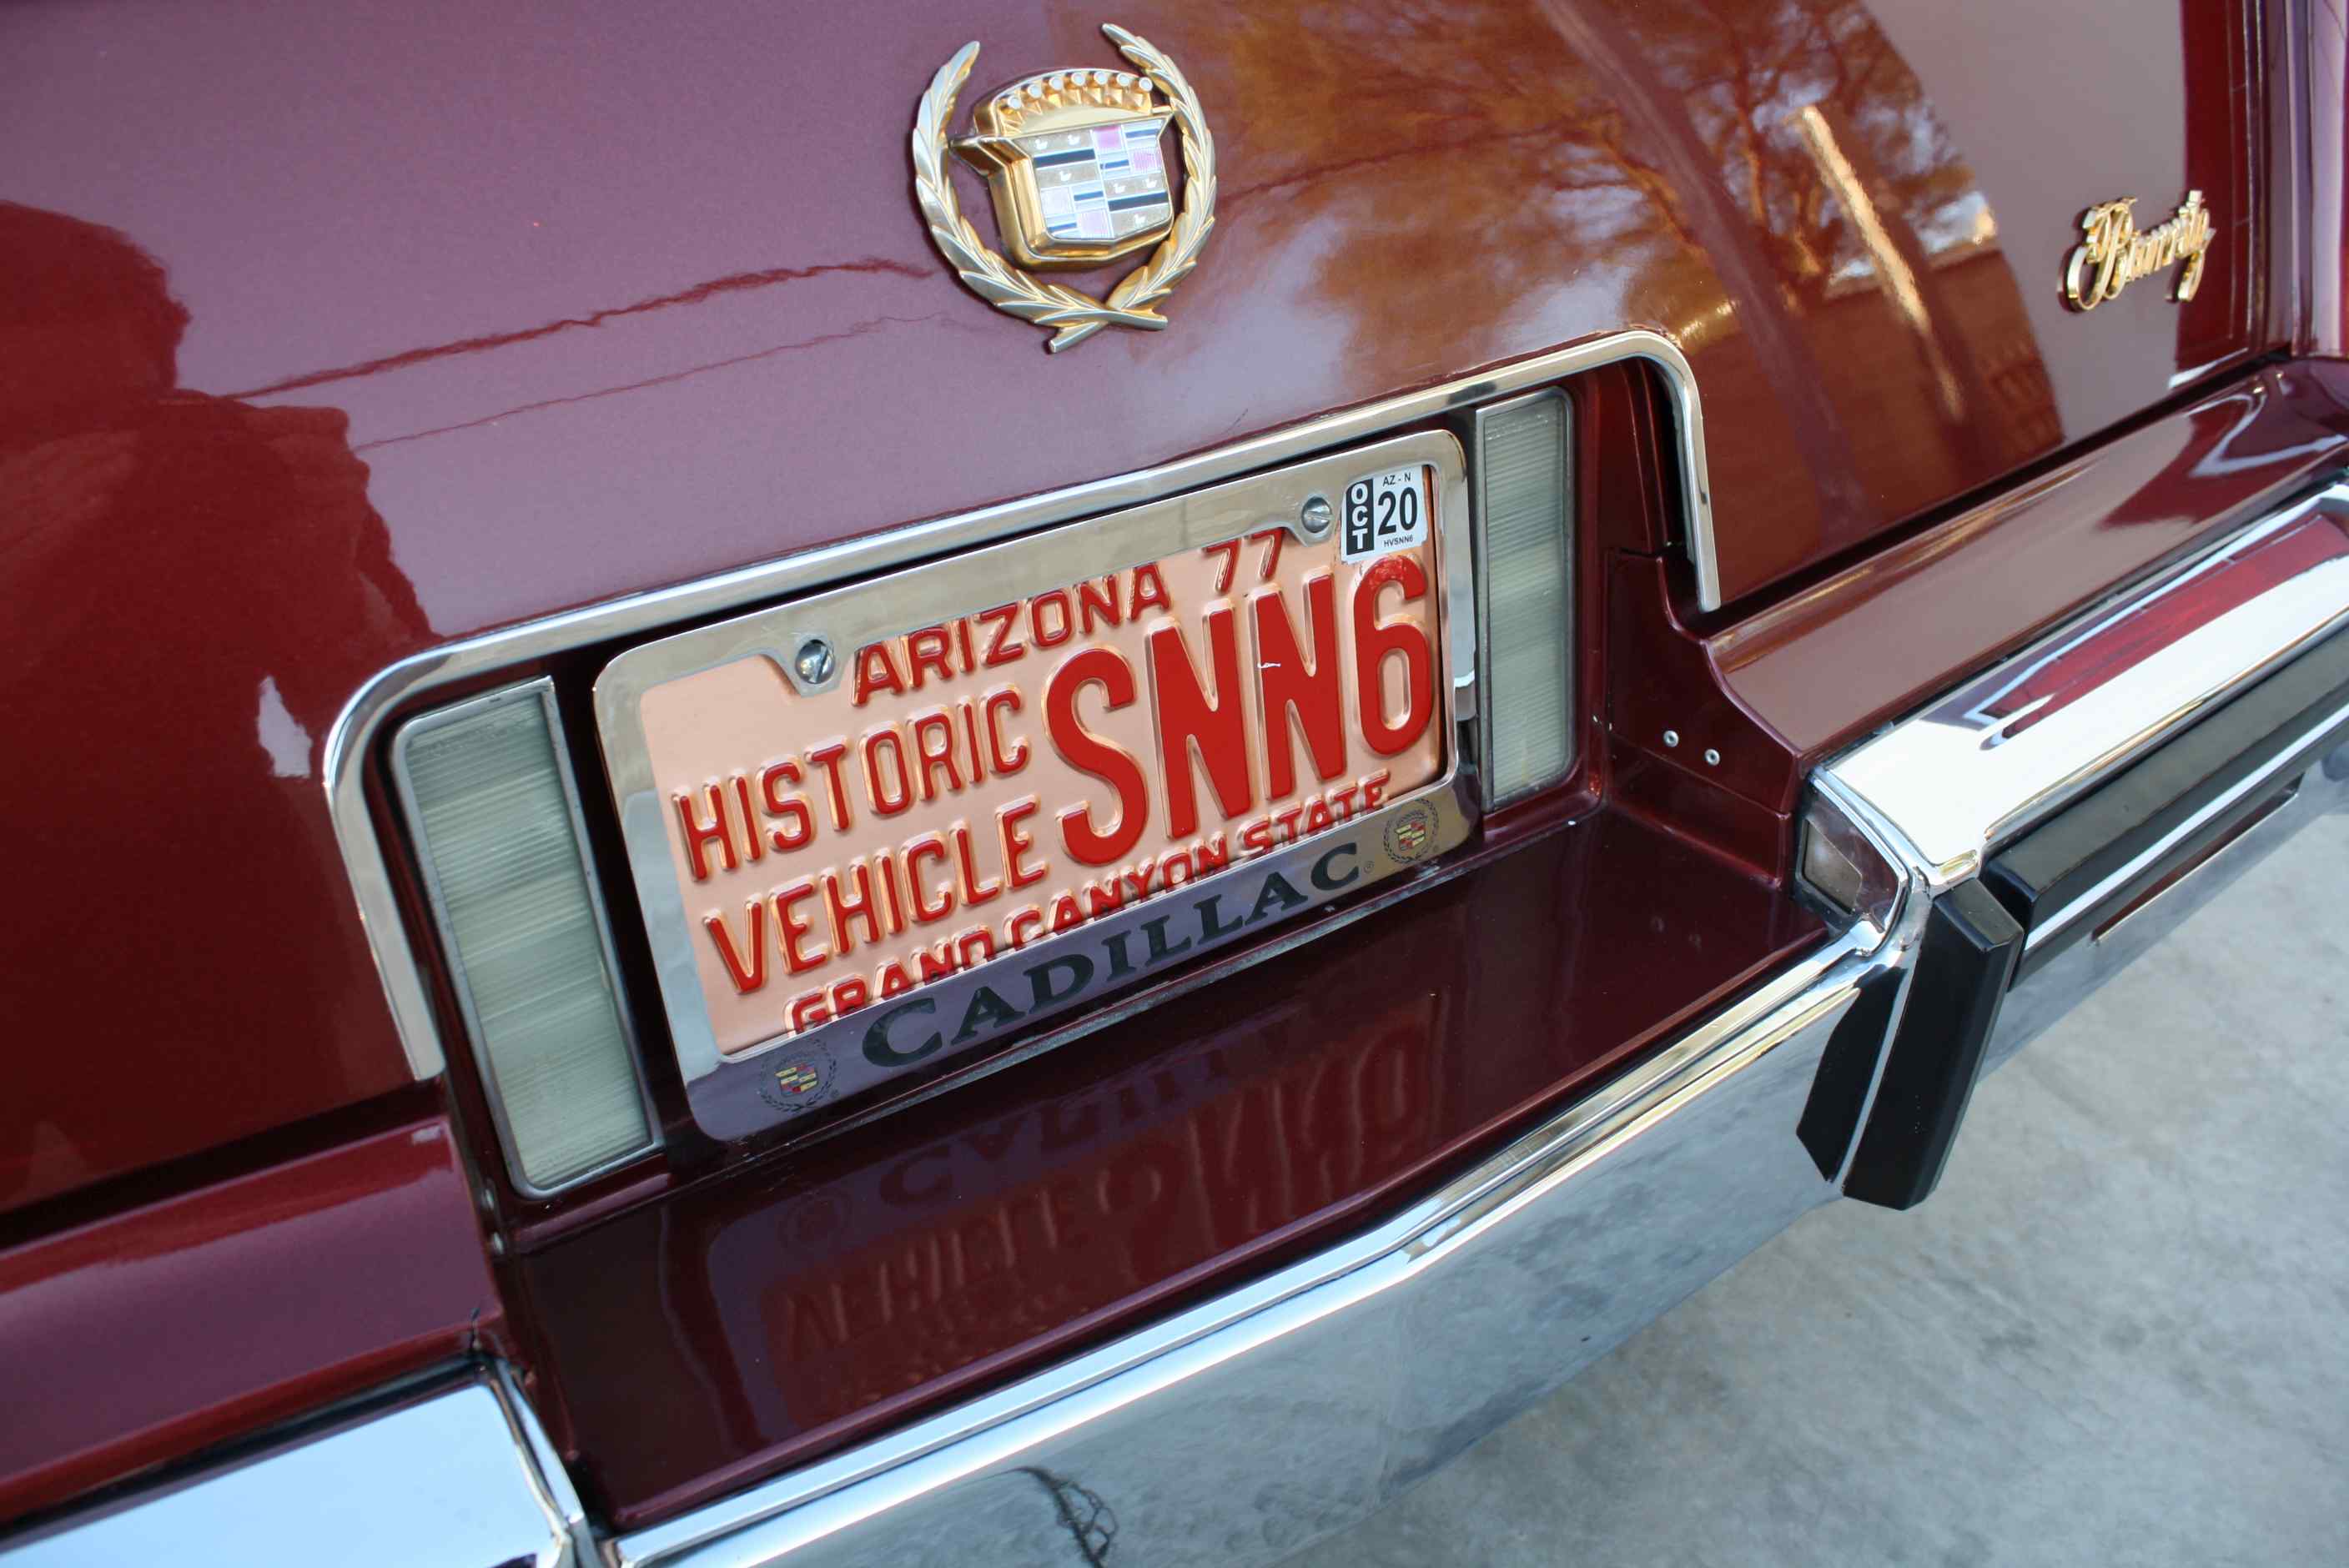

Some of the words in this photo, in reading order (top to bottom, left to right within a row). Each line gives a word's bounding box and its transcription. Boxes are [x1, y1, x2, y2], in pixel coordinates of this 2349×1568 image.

[1351, 483, 1369, 550] OCT
[1377, 487, 1418, 535] 20
[1383, 475, 1396, 486] AZ
[1404, 473, 1411, 482] N
[1383, 535, 1413, 547] HVSNN6
[853, 563, 1170, 706] ARIZONA
[1203, 527, 1285, 593] 77
[672, 684, 1030, 882] HISTORIC
[1044, 555, 1434, 867] SNN6
[705, 796, 1046, 995] VEHICLE
[786, 926, 996, 1036] GRAND
[1005, 832, 1229, 951] CANYON
[1239, 768, 1389, 860] STATE
[863, 842, 1360, 1067] CADILLAC
